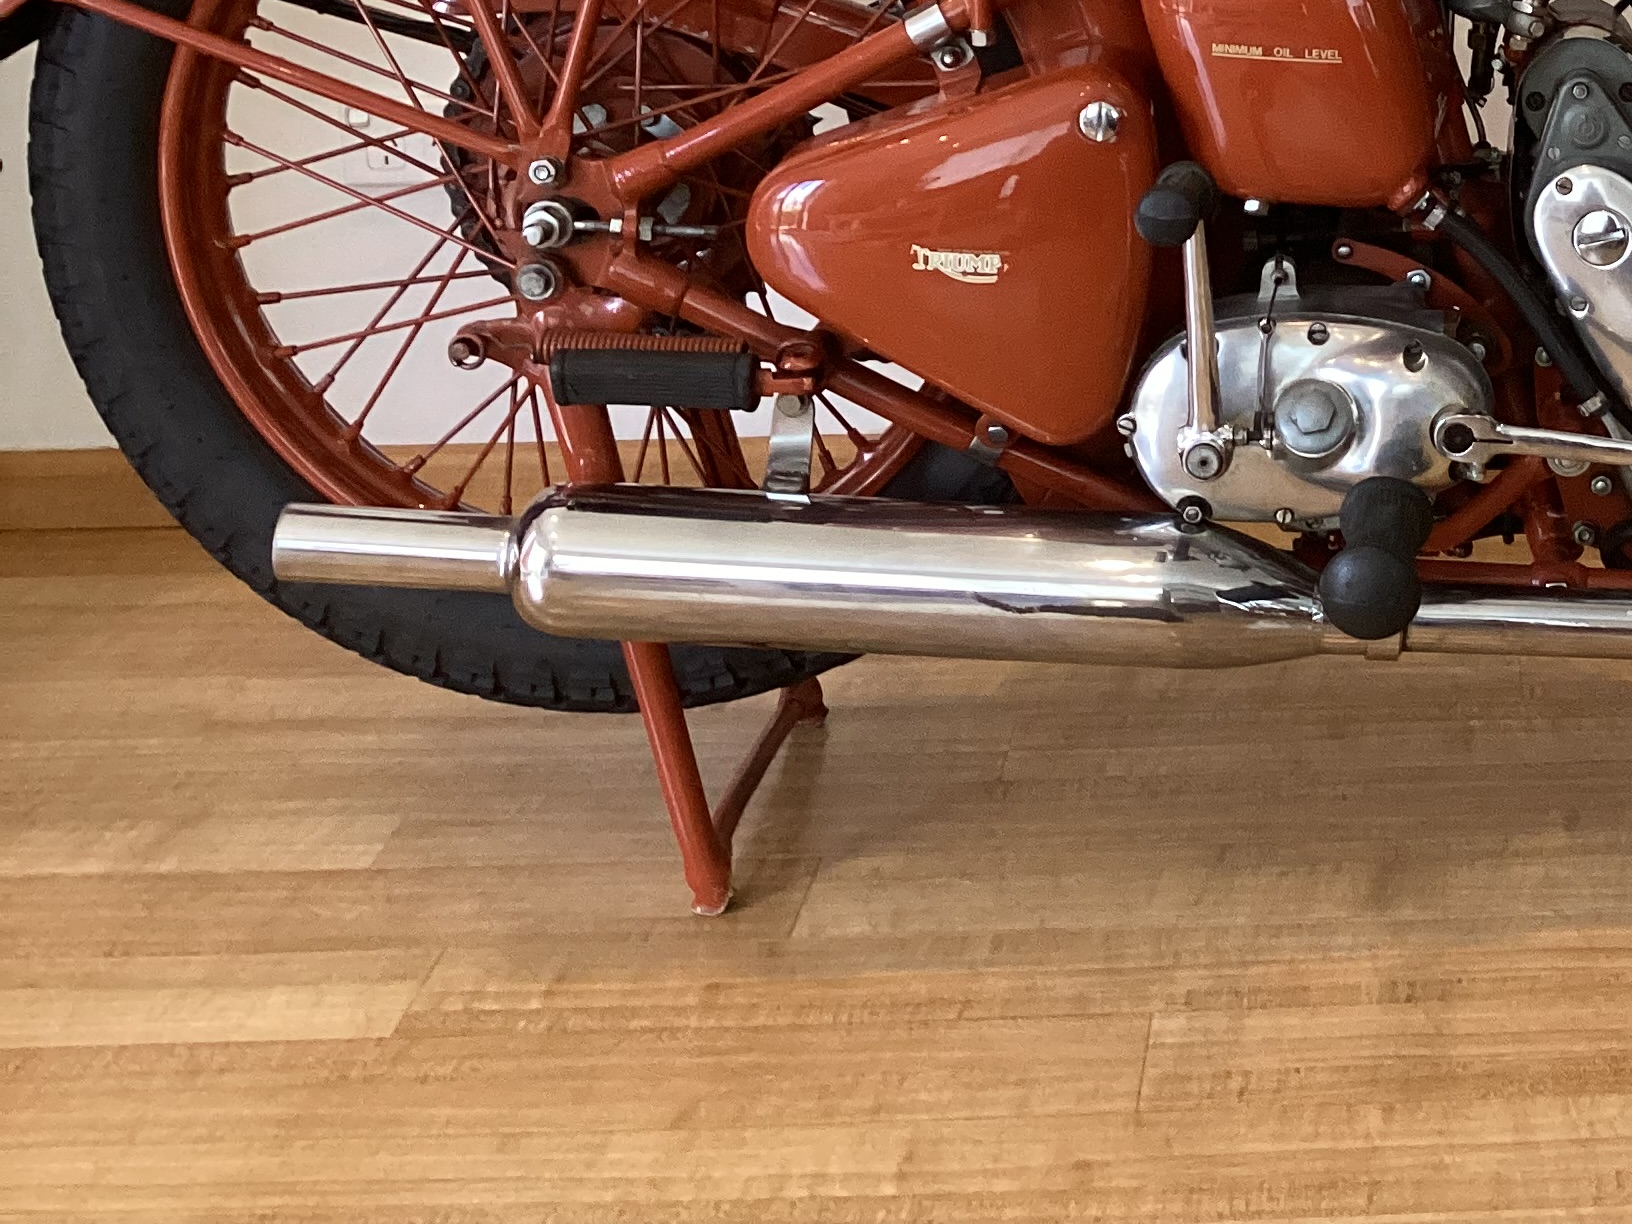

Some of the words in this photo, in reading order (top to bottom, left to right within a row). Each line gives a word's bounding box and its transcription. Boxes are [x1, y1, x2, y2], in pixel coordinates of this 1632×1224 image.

[1211, 42, 1263, 57] MINIMUM
[1273, 46, 1294, 59] OIL
[1304, 48, 1343, 61] LEVEL
